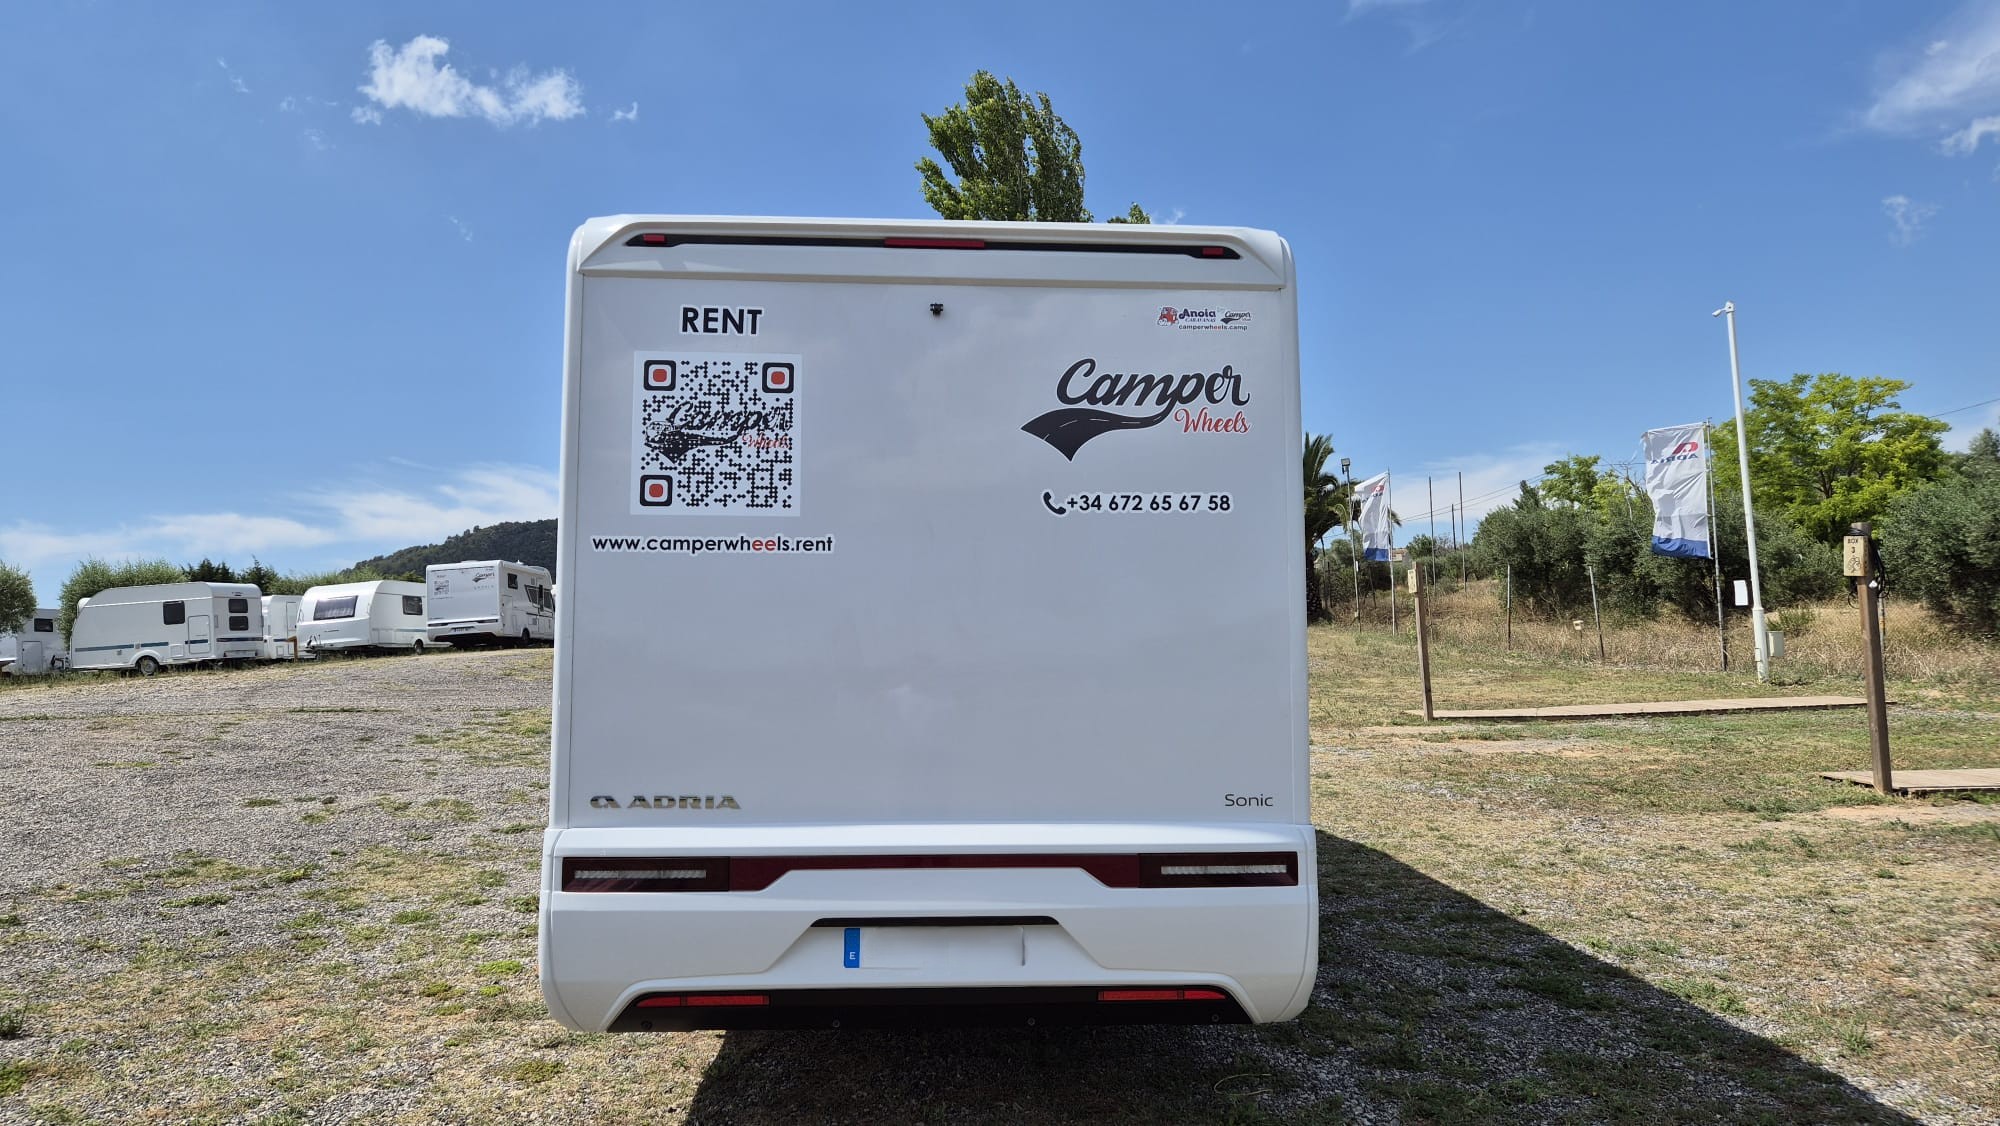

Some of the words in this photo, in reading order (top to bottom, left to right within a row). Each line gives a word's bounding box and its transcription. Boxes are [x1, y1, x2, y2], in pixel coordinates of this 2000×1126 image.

[681, 307, 763, 335] RENT
[1178, 308, 1216, 319] Anoia
[1224, 310, 1251, 319] Camper
[1178, 323, 1248, 331] camperwheels.camp
[1056, 358, 1251, 410] Camper
[668, 400, 793, 434] Camper
[1174, 406, 1251, 433] Wheels
[1066, 495, 1102, 511] +34
[1108, 495, 1143, 511] 672
[1150, 495, 1172, 511] 65
[1179, 495, 1202, 511] 67
[1208, 495, 1231, 511] 58
[592, 535, 833, 554] www.camperwheels.rent
[627, 795, 742, 809] ADRIA
[1224, 793, 1274, 807] Sonic
[849, 951, 857, 960] E
